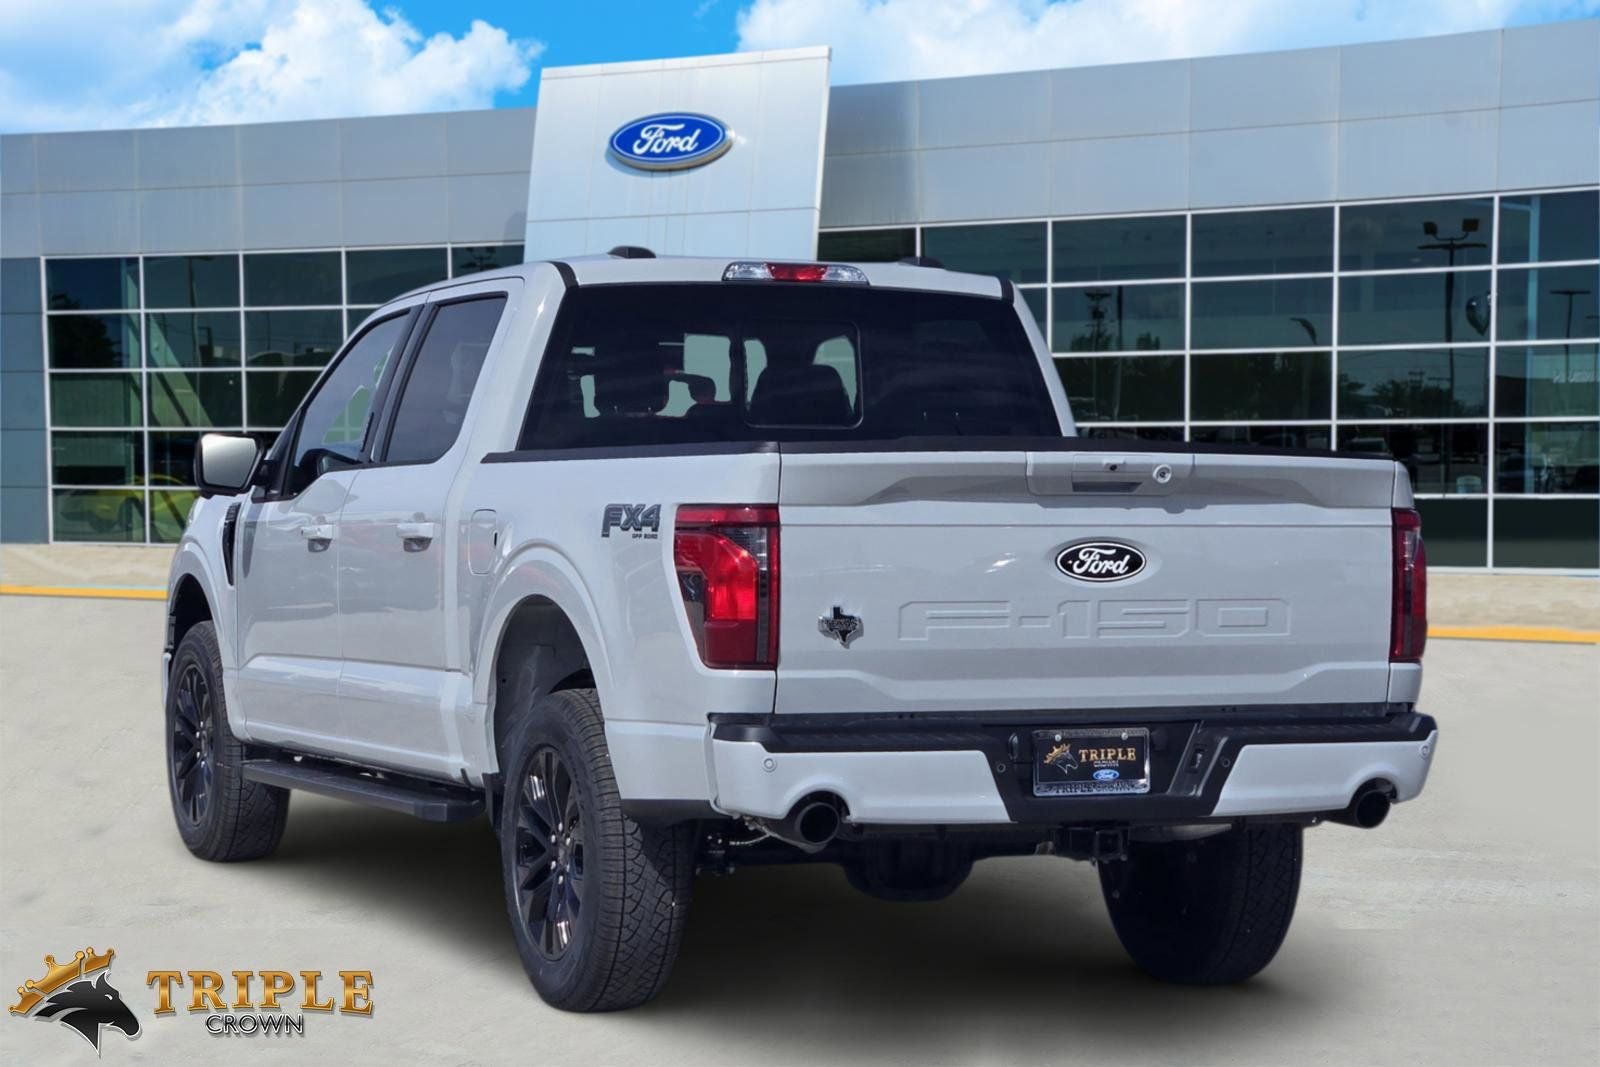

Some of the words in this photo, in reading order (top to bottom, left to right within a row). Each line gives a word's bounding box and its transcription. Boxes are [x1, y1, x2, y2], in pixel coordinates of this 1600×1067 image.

[632, 123, 702, 155] Ford
[601, 503, 661, 538] FX4
[1072, 547, 1131, 574] Ford
[898, 598, 1292, 641] F-150
[1078, 747, 1137, 763] TRIPLE
